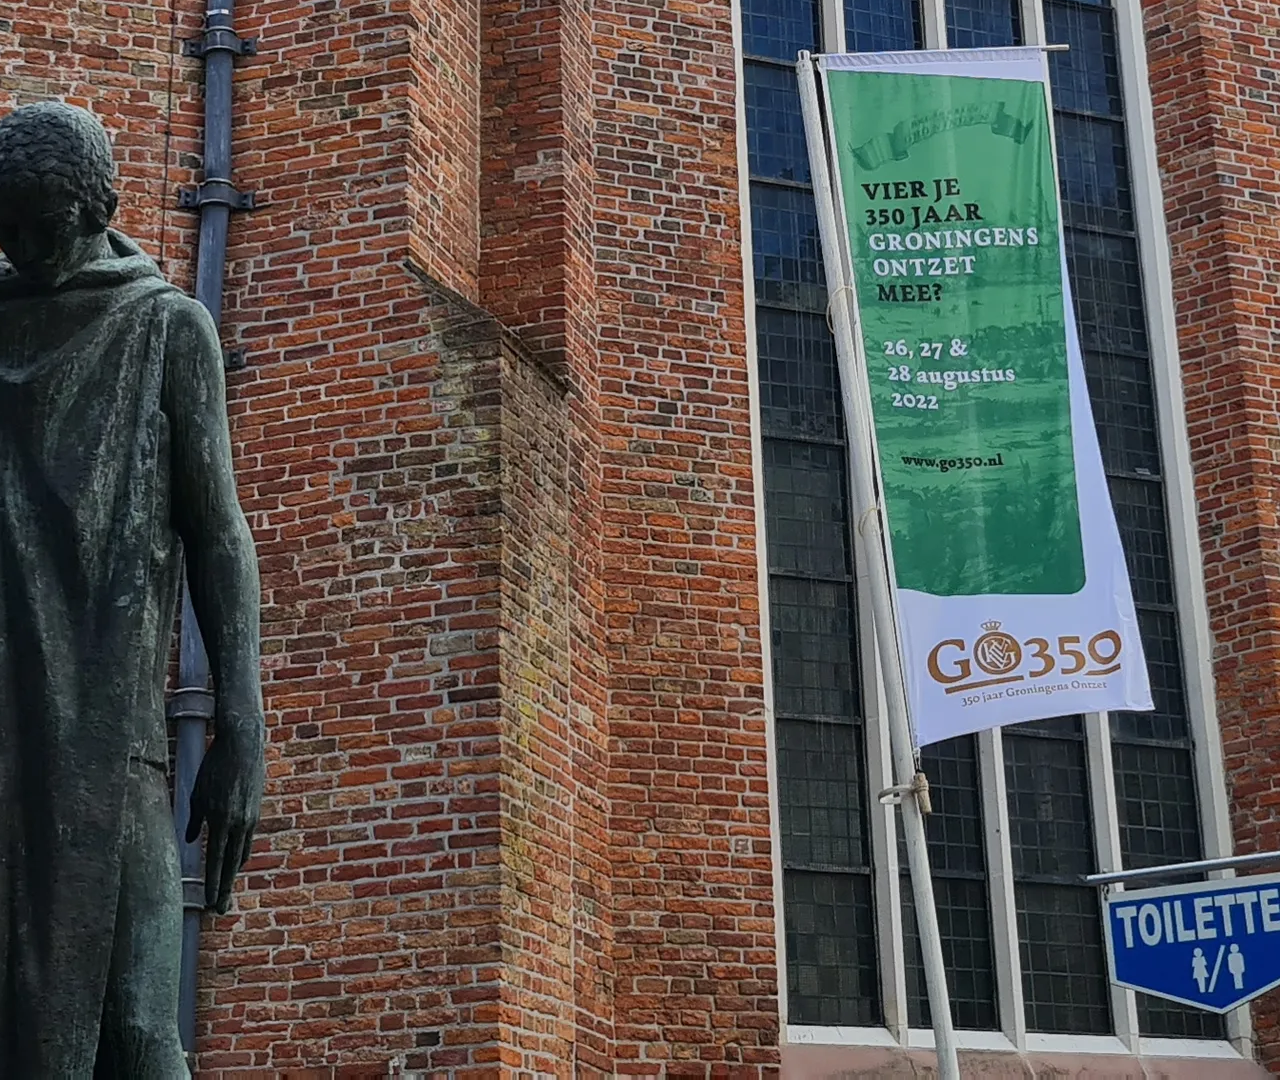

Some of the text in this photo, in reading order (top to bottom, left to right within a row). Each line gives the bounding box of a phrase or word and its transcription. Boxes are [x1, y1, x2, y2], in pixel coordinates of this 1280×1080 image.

[862, 178, 960, 202] VIER JE
[865, 203, 983, 229] 350 JAAR
[870, 227, 1038, 251] GRONINGENS
[874, 255, 975, 276] ONTZET
[877, 283, 942, 302] MEE?
[884, 338, 968, 360] 26, 27 &
[888, 367, 1016, 390] 28 augustus
[891, 393, 939, 410] 2022
[901, 454, 1003, 473] www.go350.nl
[961, 680, 1107, 707] 350 jaar Groningens Ontzet
